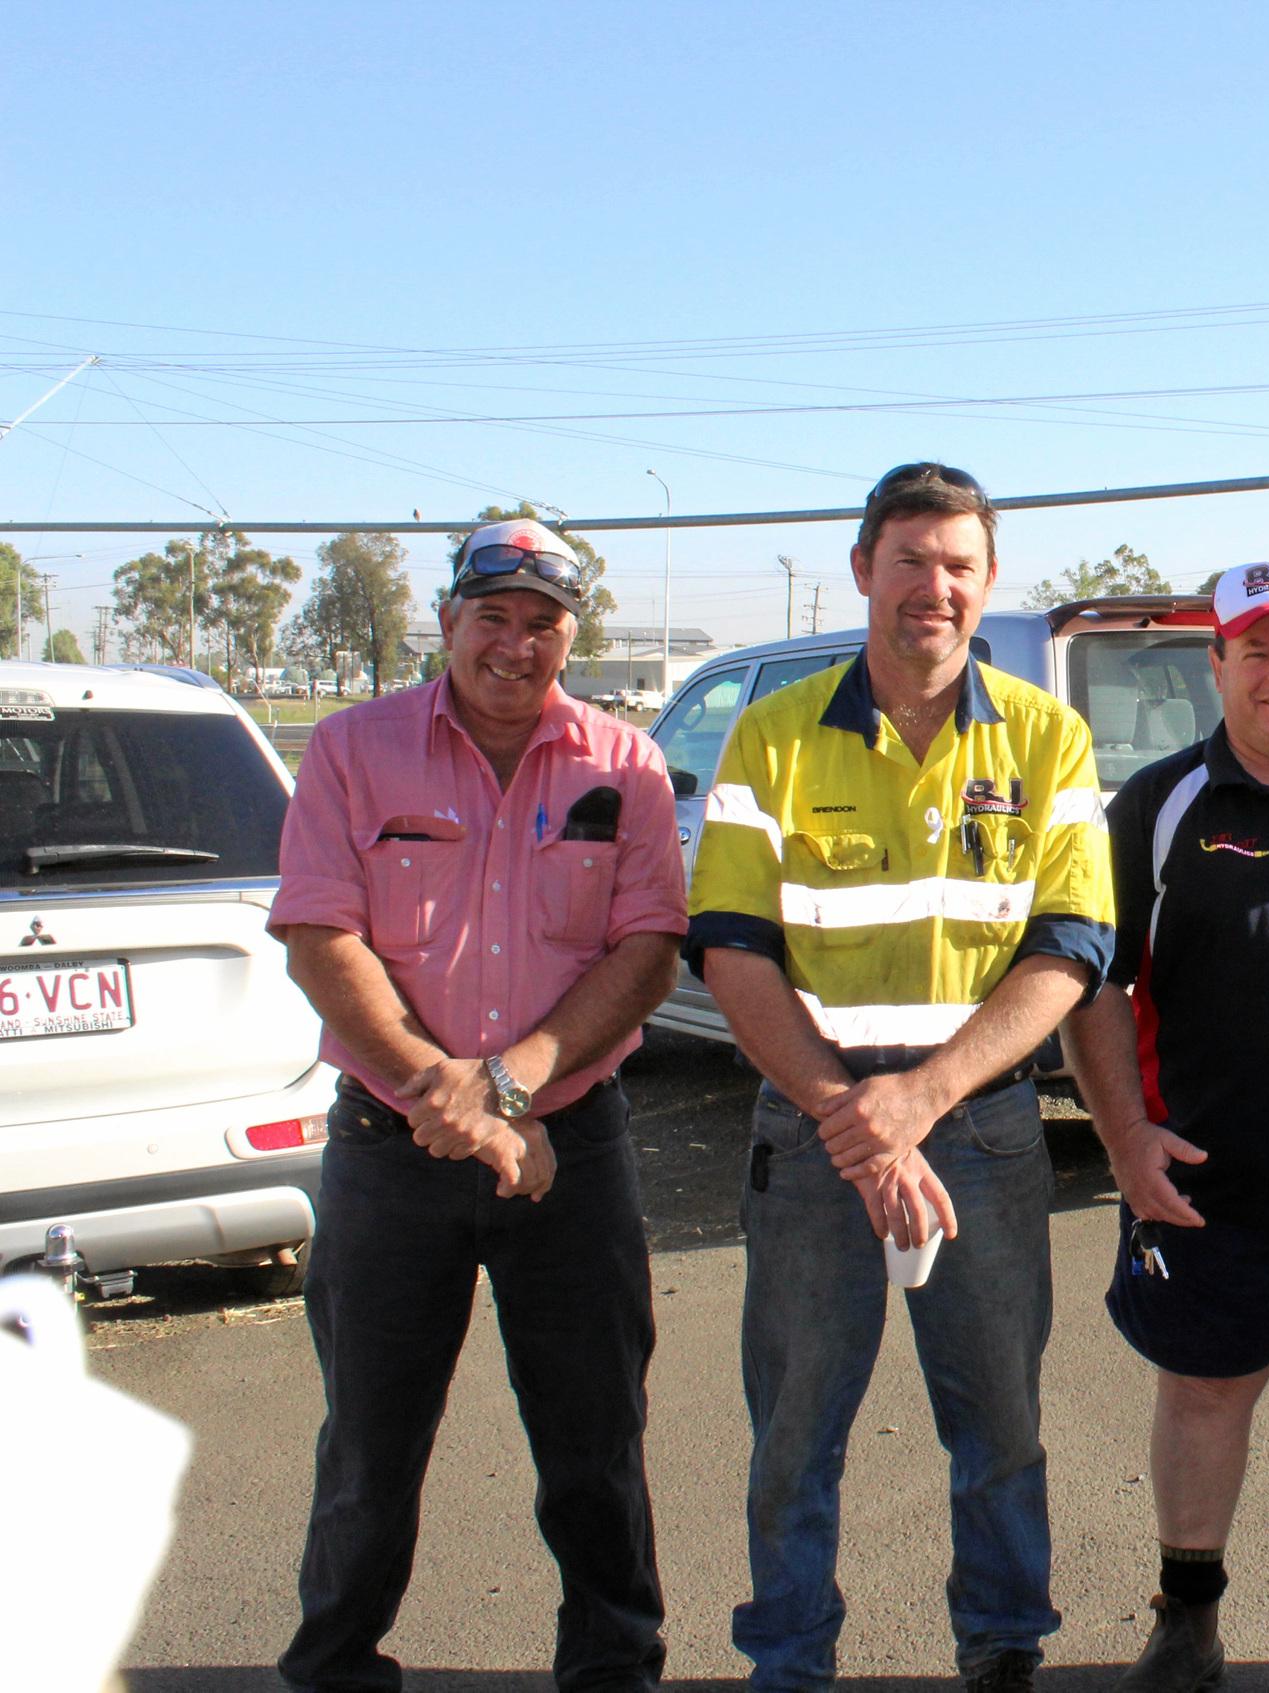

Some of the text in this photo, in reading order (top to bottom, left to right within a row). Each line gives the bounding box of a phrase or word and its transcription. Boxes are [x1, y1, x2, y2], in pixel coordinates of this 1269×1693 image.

[812, 805, 857, 814] BRENDON
[966, 803, 1020, 815] HYDRAULICS
[54, 961, 84, 969] DALBY
[92, 1011, 122, 1024] STATE
[44, 1021, 113, 1033] MITSUBISHI
